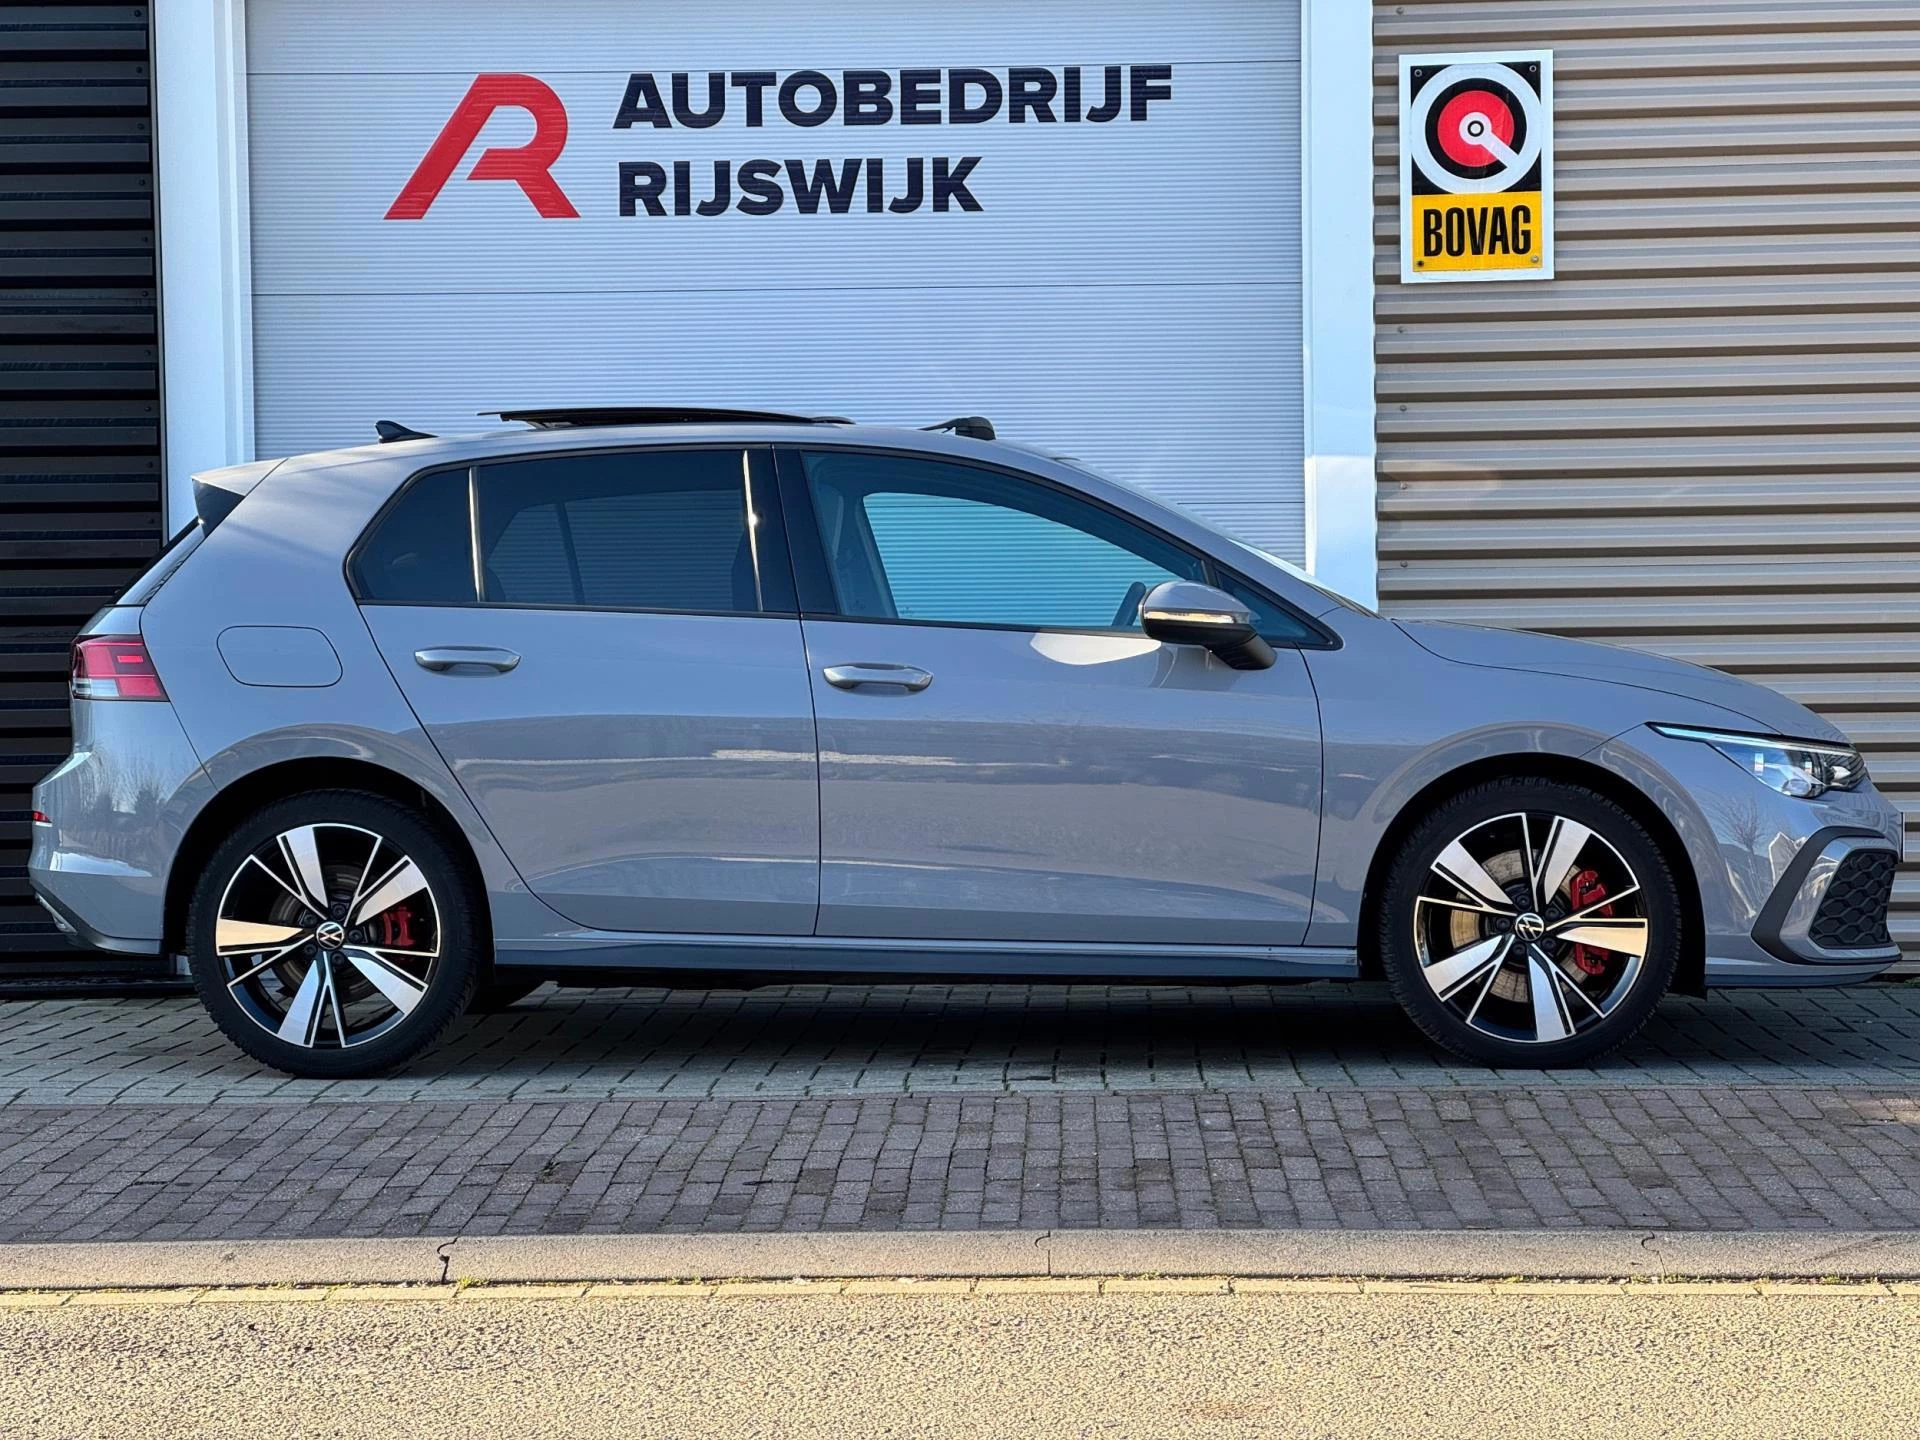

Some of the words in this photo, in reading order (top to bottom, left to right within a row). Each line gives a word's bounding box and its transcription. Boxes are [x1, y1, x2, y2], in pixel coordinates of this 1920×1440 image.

[613, 65, 1172, 128] AUTOBEDRIJF
[619, 156, 983, 217] RIJSWIJK
[1424, 205, 1531, 257] BOVAG
